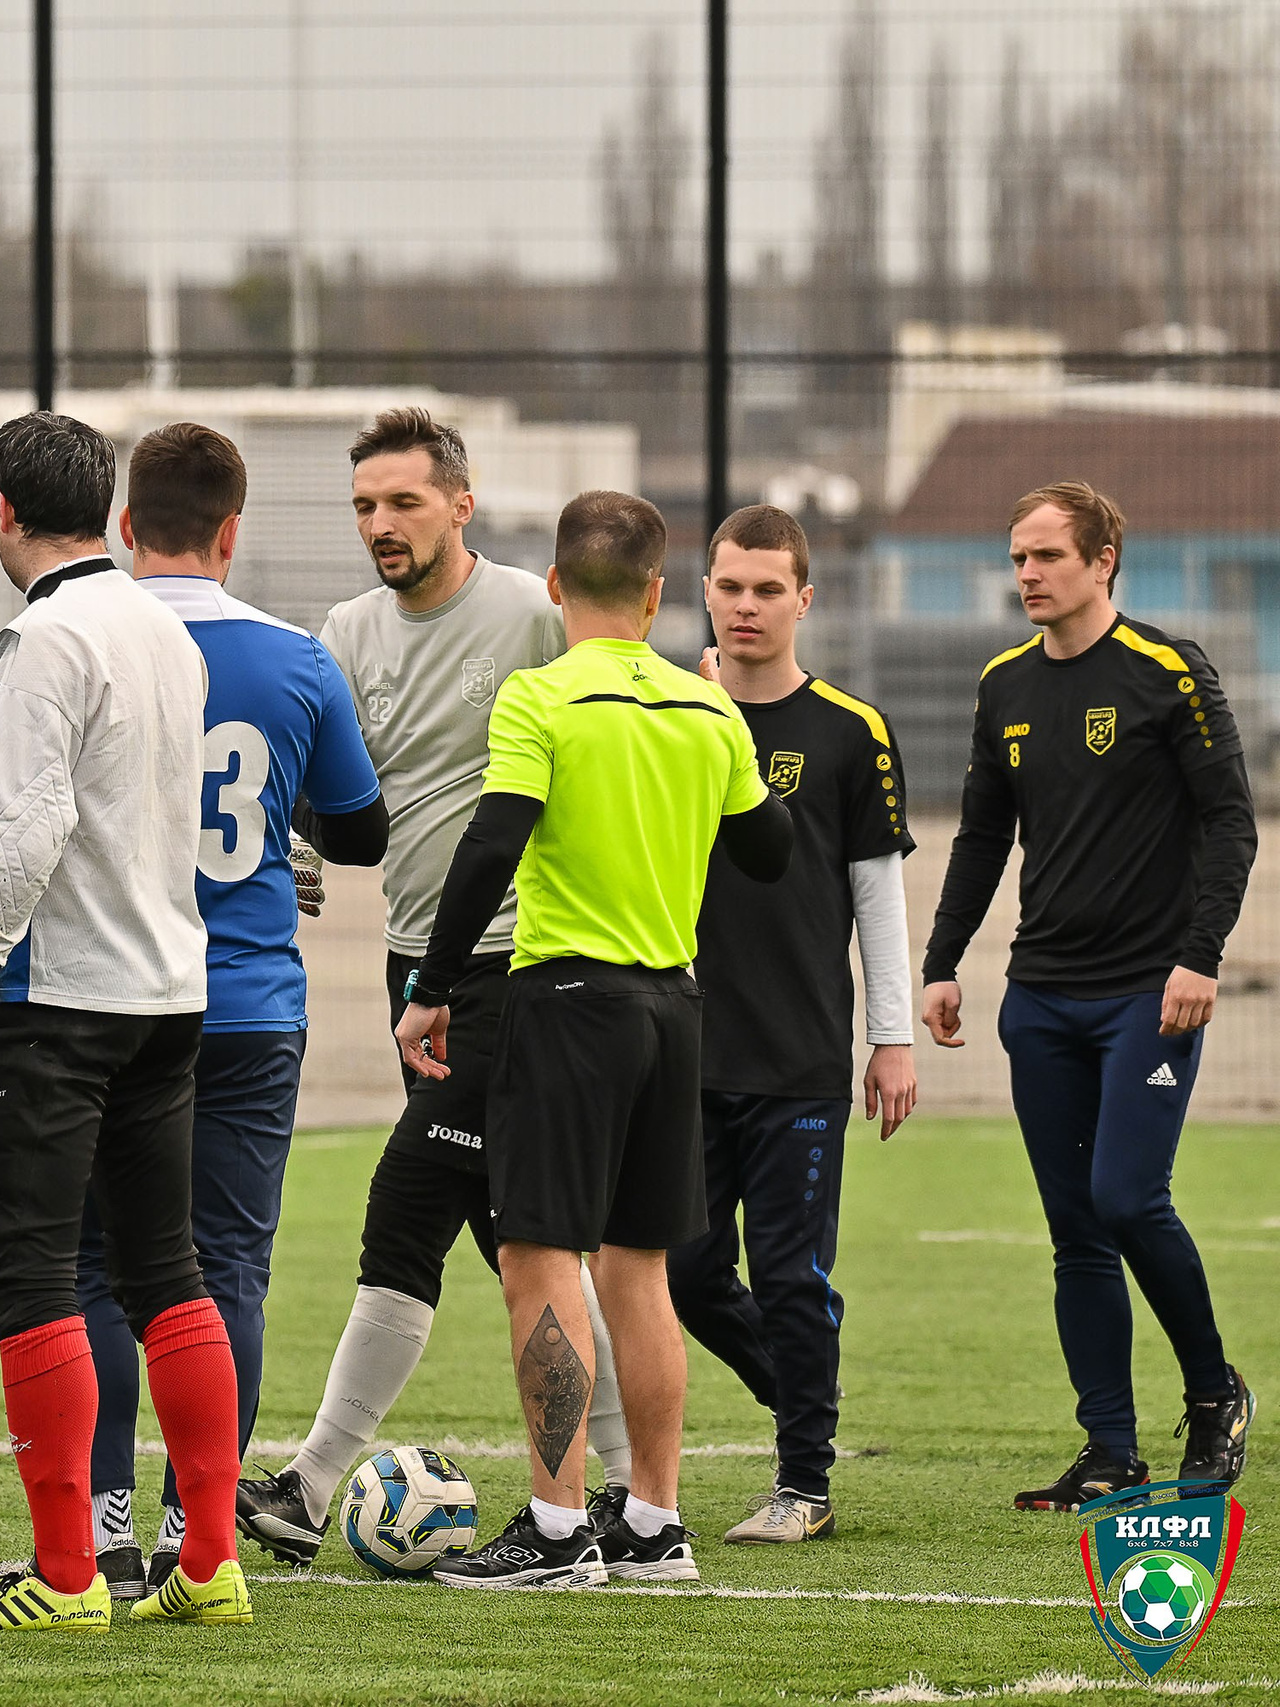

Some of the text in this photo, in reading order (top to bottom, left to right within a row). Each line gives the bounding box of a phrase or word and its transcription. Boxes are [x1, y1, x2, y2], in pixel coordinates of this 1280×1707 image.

[367, 696, 392, 723] 22
[1003, 723, 1030, 739] JAKO
[1009, 742, 1020, 768] 8
[1147, 1077, 1177, 1086] adidas
[791, 1117, 828, 1131] JAKO
[427, 1123, 483, 1149] Joma
